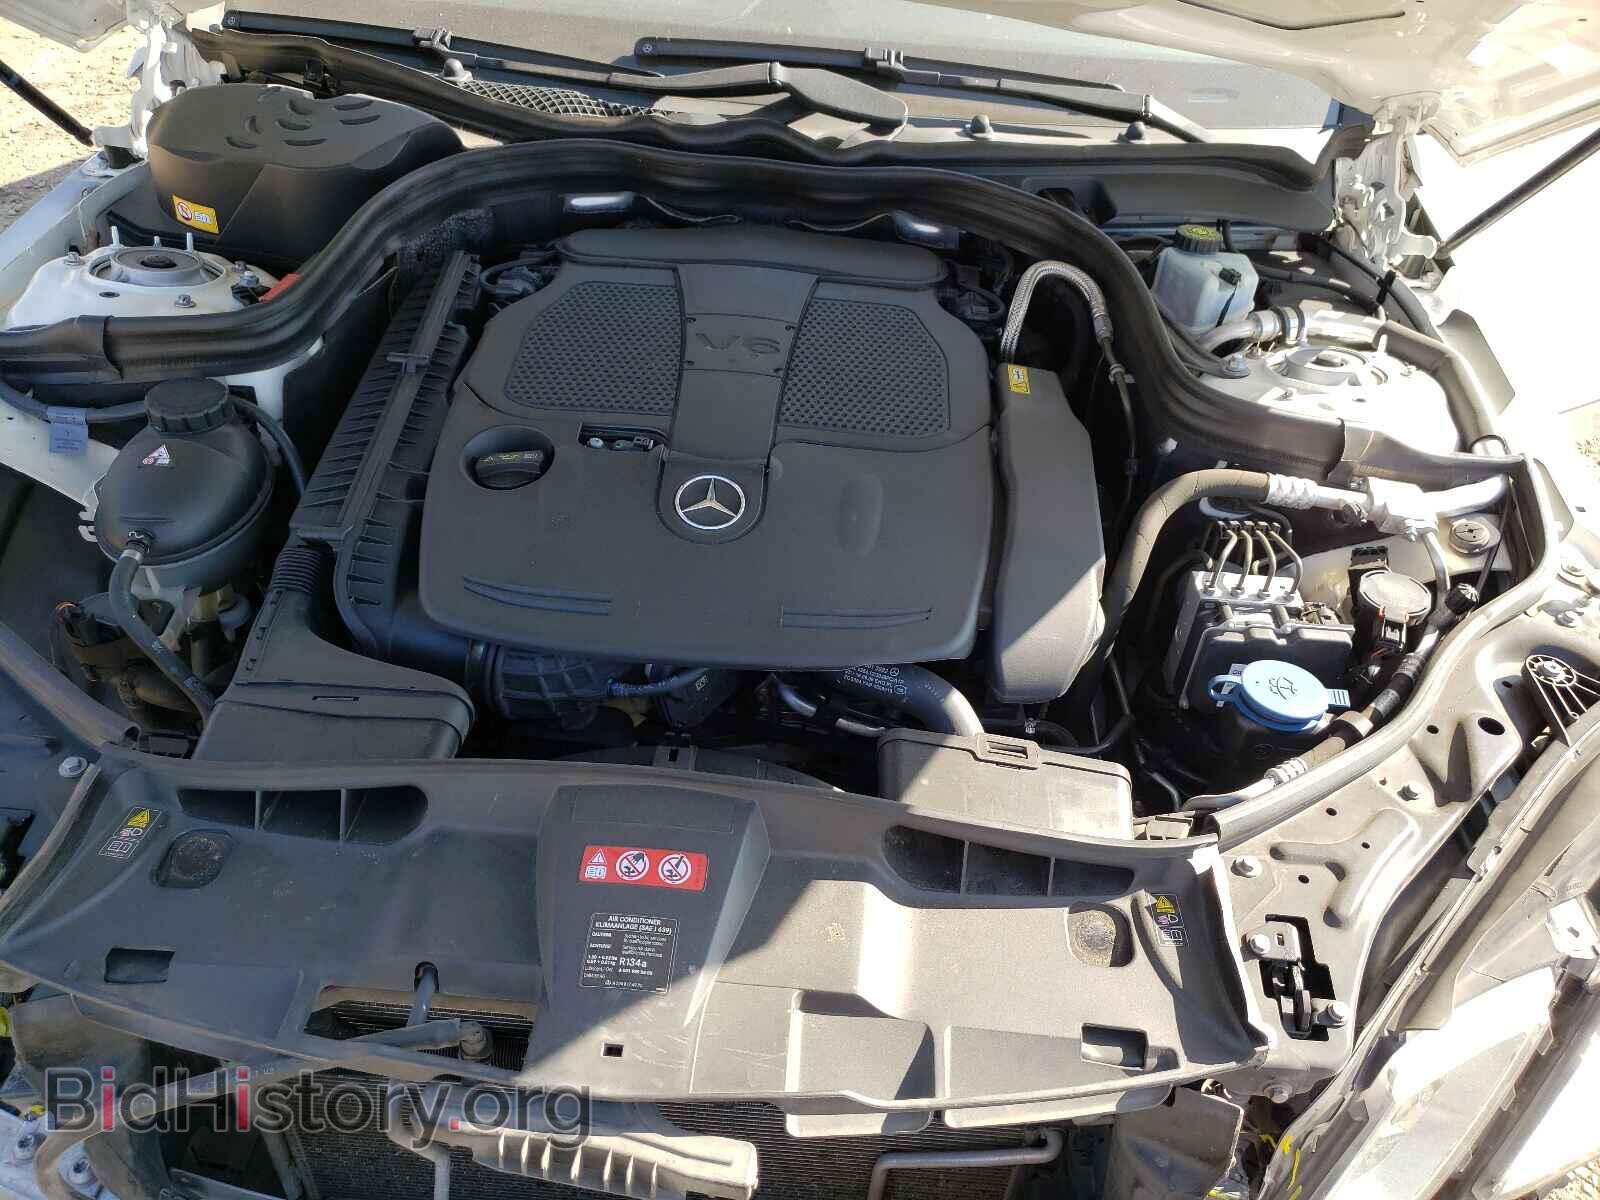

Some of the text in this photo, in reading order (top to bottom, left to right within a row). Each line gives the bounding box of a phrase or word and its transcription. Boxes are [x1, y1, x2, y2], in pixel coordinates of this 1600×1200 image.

[696, 332, 781, 355] V6
[595, 921, 638, 931] KLIMAANLAGE
[620, 916, 661, 926] CONDITIONER
[619, 957, 647, 968] R134a
